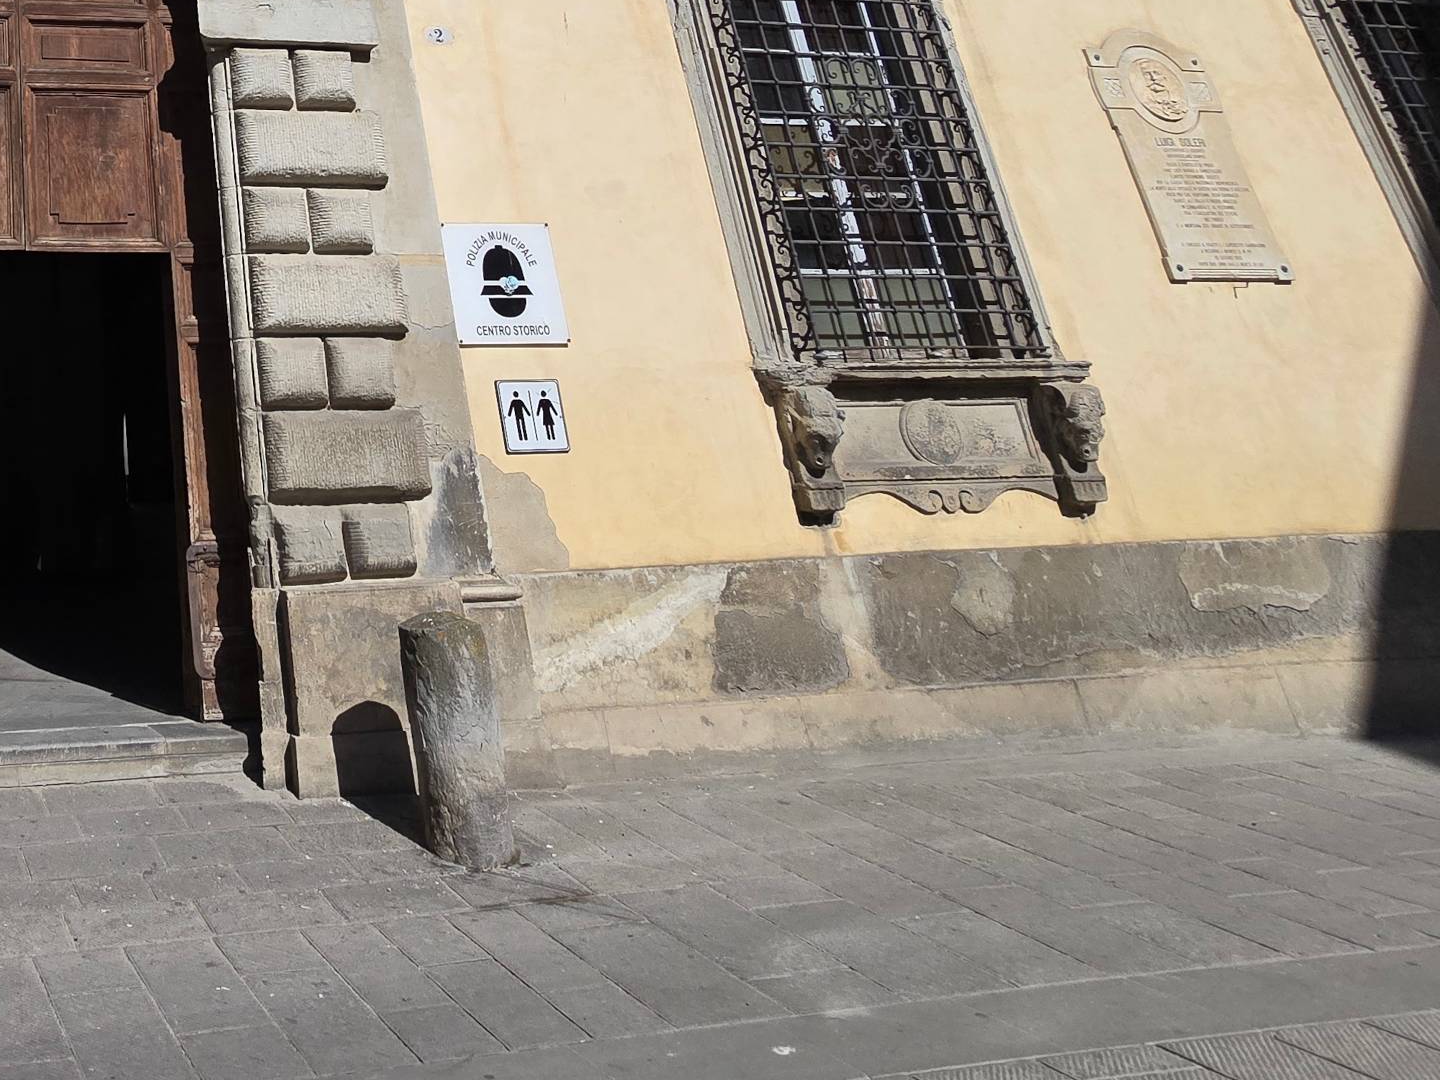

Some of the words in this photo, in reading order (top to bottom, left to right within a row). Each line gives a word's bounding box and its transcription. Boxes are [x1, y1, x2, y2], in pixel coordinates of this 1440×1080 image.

[466, 235, 489, 267] POLIZIA
[487, 231, 538, 267] MUNICIPALE
[476, 325, 512, 336] CENTRO
[513, 325, 551, 336] STORICO
